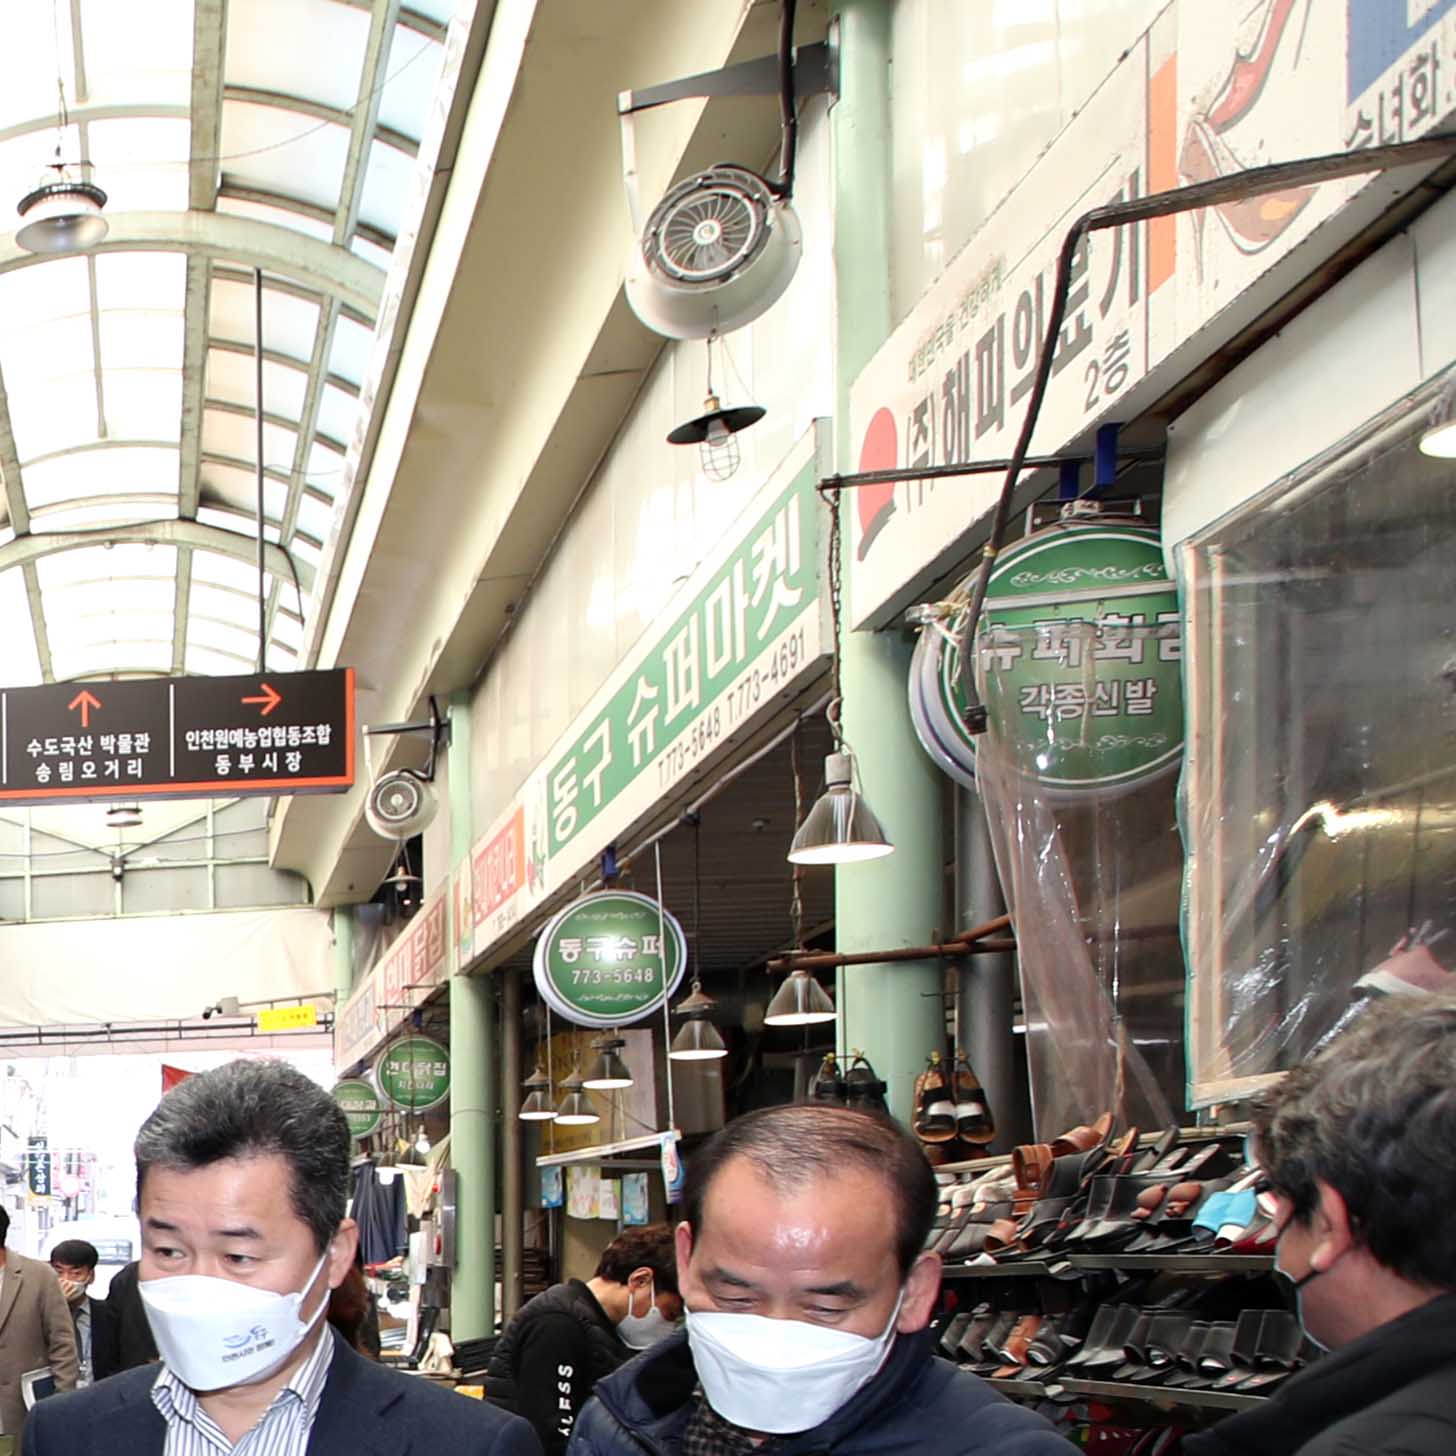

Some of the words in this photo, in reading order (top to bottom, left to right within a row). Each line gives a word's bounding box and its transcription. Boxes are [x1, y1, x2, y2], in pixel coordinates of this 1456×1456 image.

[550, 716, 615, 846] 동구
[626, 494, 804, 768] 슈퍼마켓
[1019, 679, 1157, 720] 각종신발
[26, 735, 93, 758] 수도국산
[99, 733, 150, 755] 박물관
[184, 723, 332, 752] 인천원예농업협동조합
[35, 758, 144, 783] 송림오거리
[214, 752, 303, 776] 동부시장
[559, 935, 665, 963] 동구슈퍼
[571, 967, 655, 985] 773-5648
